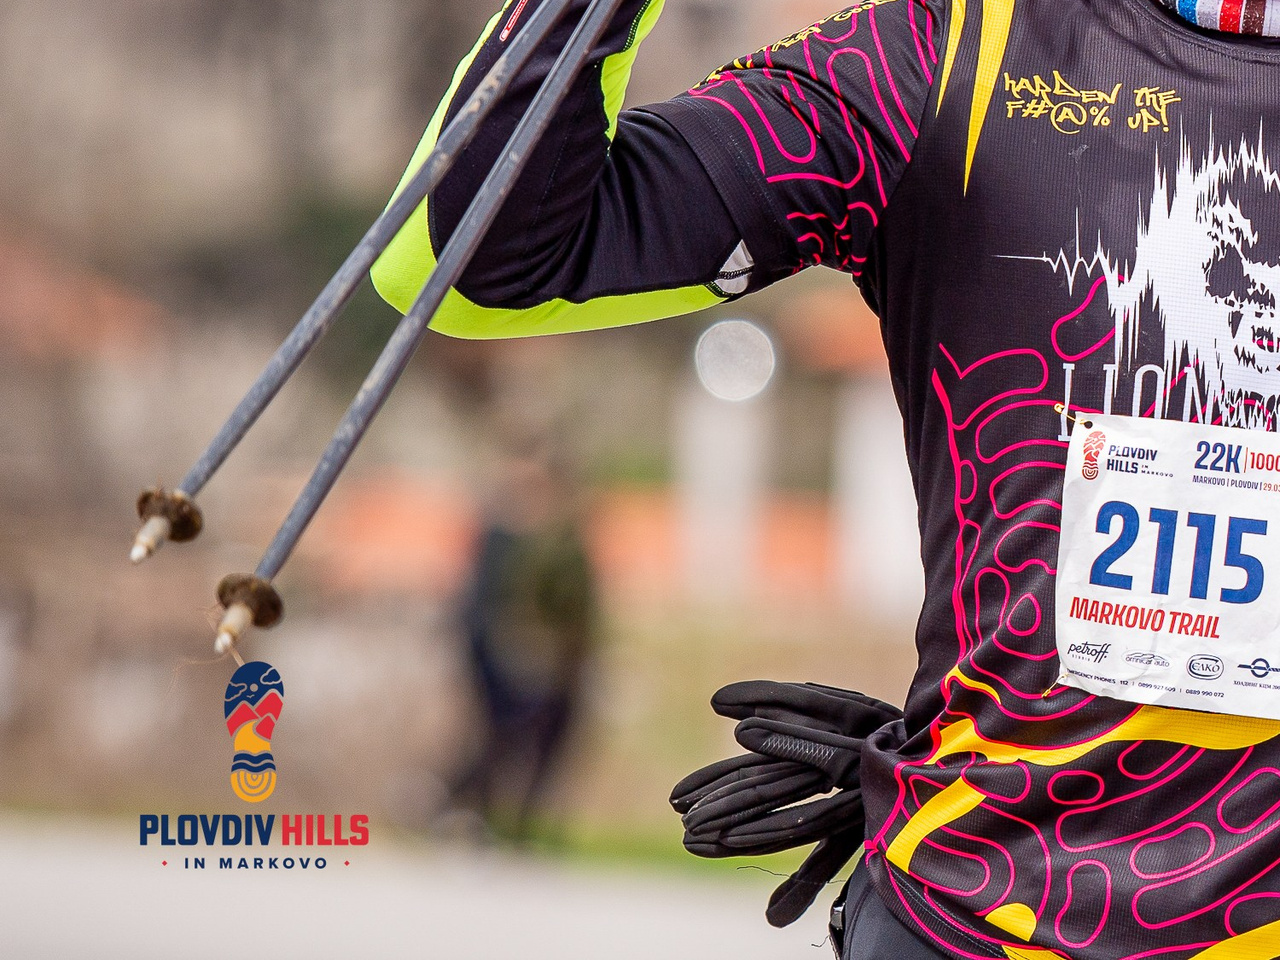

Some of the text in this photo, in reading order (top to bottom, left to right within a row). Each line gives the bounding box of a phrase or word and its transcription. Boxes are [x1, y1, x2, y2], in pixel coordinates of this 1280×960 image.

[1108, 444, 1158, 461] PLOVDIV
[1194, 440, 1243, 474] 22K
[1106, 458, 1139, 474] HILLS
[1192, 474, 1226, 487] MARKOVO
[1230, 479, 1259, 490] PLOVDIV
[1089, 500, 1268, 604] 2115
[1069, 596, 1221, 639] MARKOVO TRAIL
